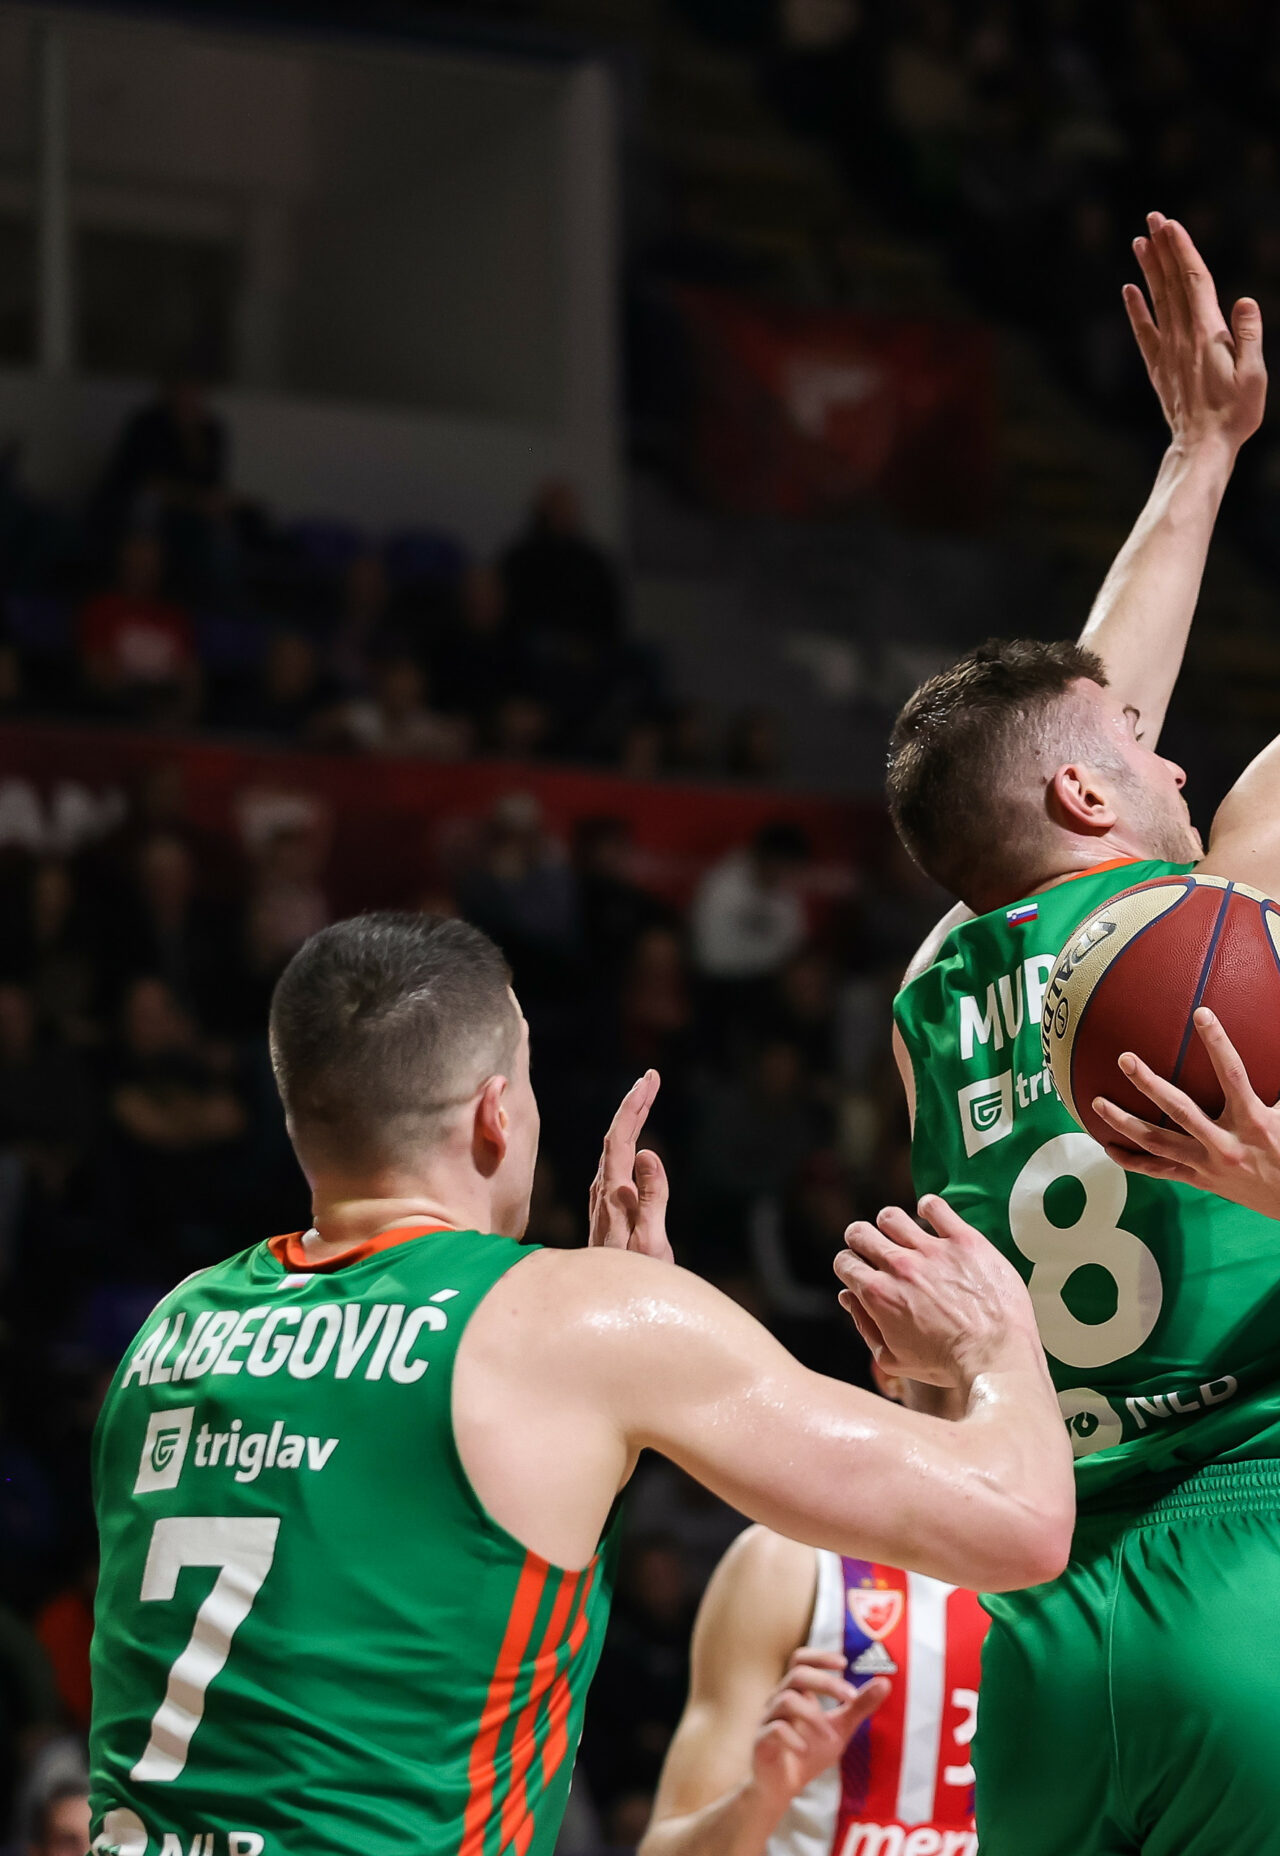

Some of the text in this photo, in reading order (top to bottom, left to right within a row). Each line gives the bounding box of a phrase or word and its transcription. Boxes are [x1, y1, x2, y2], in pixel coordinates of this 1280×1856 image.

[959, 953, 1056, 1061] MUR
[1043, 911, 1117, 1078] SPALDIN
[1008, 1132, 1163, 1369] 8
[121, 1289, 460, 1389] ALIBEGOVIĆ
[193, 1418, 339, 1483] triglav
[130, 1516, 281, 1782] 7
[838, 1817, 971, 1856] meri
